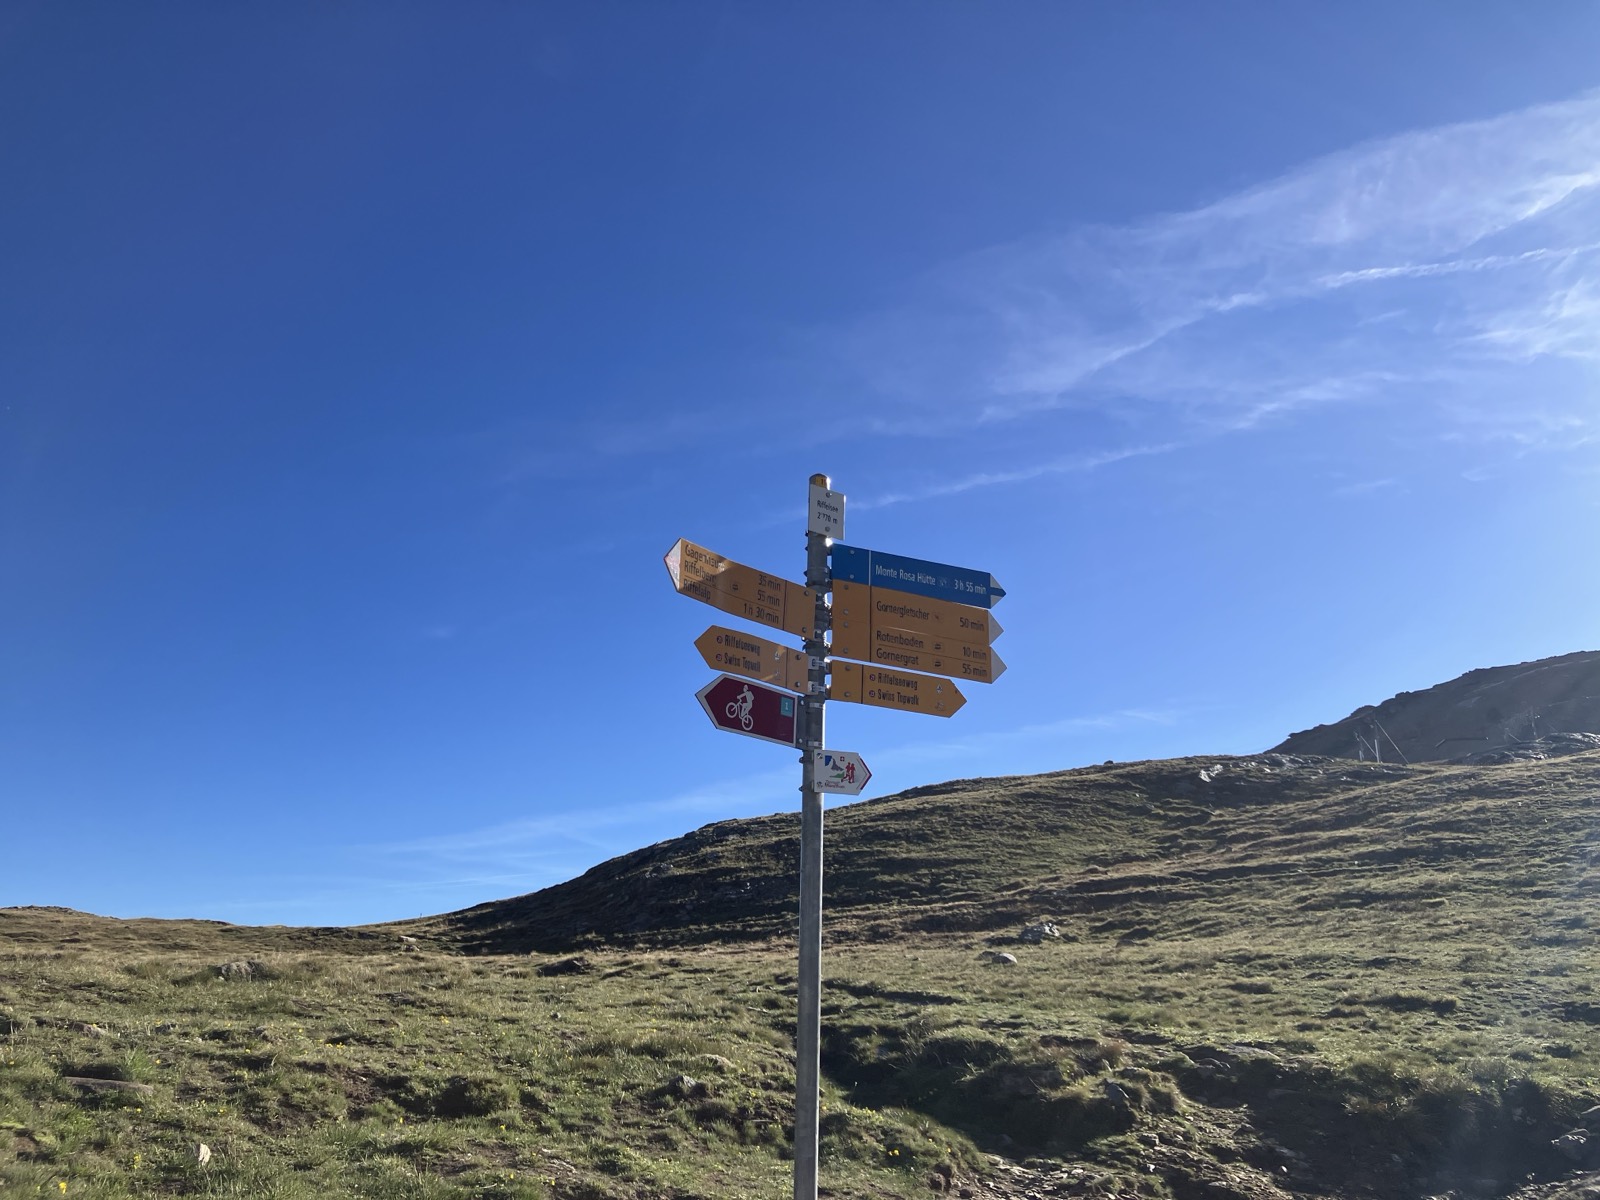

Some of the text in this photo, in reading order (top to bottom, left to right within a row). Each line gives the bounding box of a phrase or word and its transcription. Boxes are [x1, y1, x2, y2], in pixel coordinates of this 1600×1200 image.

[685, 544, 725, 573] Gagenhau
[685, 561, 717, 586] Riffelberg
[875, 564, 936, 586] Monte Rosa Hütte
[684, 579, 711, 602] Riffelalp
[758, 574, 781, 591] 35 min
[954, 579, 987, 595] 3 h 55 min
[757, 590, 780, 607] 55 min
[756, 608, 765, 619] 30
[765, 611, 779, 624] min
[876, 601, 930, 620] Gornergletscher
[959, 617, 985, 631] 50 min
[876, 630, 924, 648] Rotenboden
[876, 648, 919, 666] Gornergrat
[963, 646, 987, 660] 10 min
[962, 663, 987, 677] 55 min
[877, 688, 895, 701] Swiss
[897, 691, 919, 705] Topwalk
